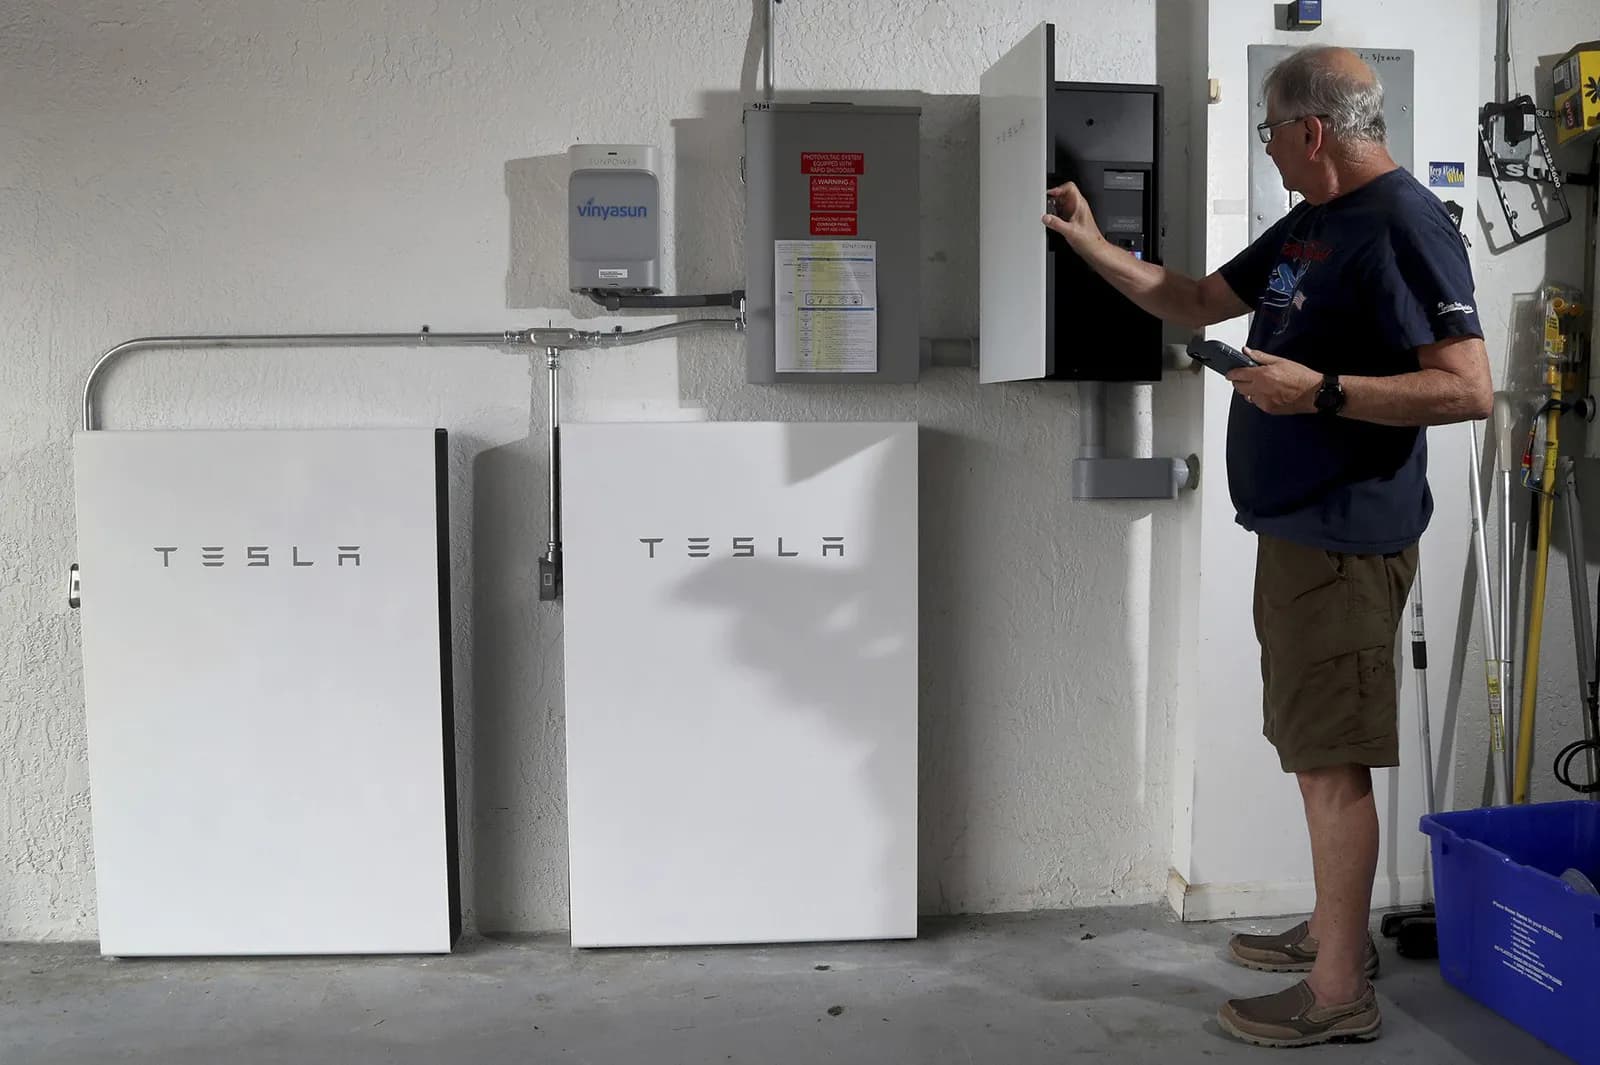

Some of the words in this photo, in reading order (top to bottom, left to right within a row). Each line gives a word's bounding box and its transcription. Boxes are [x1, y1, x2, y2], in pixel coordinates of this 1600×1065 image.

[577, 197, 648, 221] vinyasun
[153, 546, 361, 567] TESLA
[639, 537, 844, 558] TESLA
